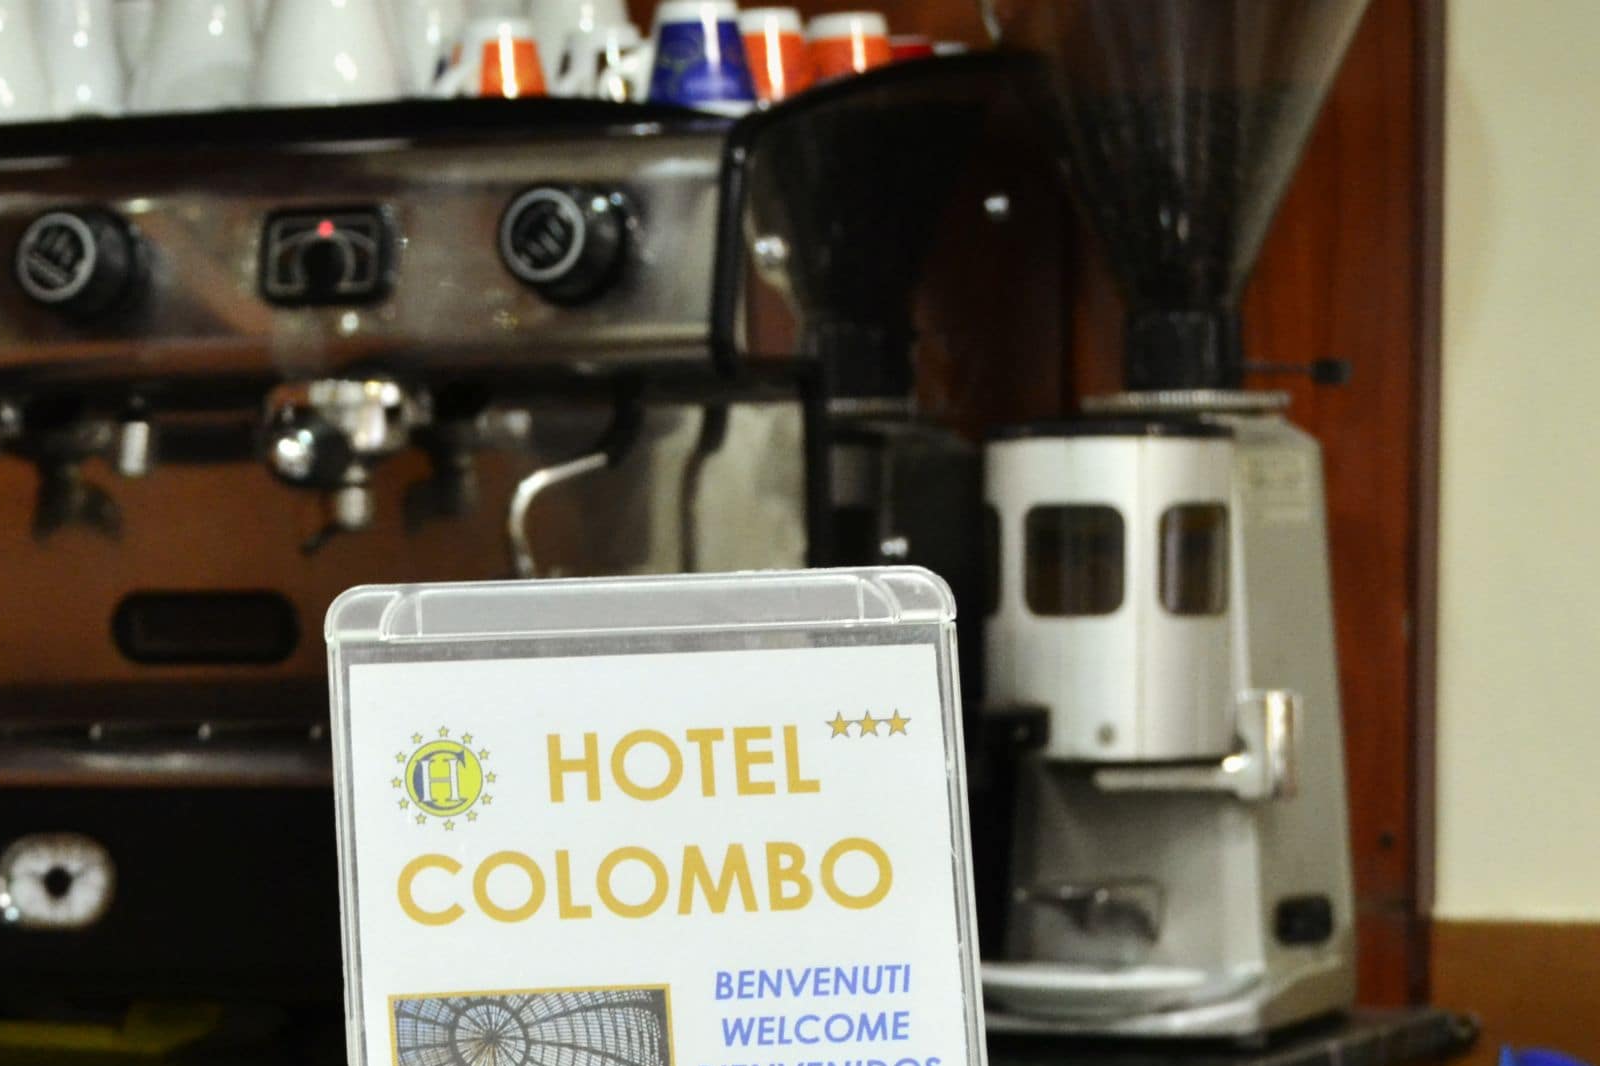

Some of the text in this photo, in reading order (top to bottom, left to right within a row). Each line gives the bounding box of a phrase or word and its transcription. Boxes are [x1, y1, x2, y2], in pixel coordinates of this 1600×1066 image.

[547, 725, 821, 803] HOTEL
[397, 837, 893, 926] COLOMBO
[714, 964, 911, 1000] BENVENUTI
[721, 1011, 910, 1047] WELCOME
